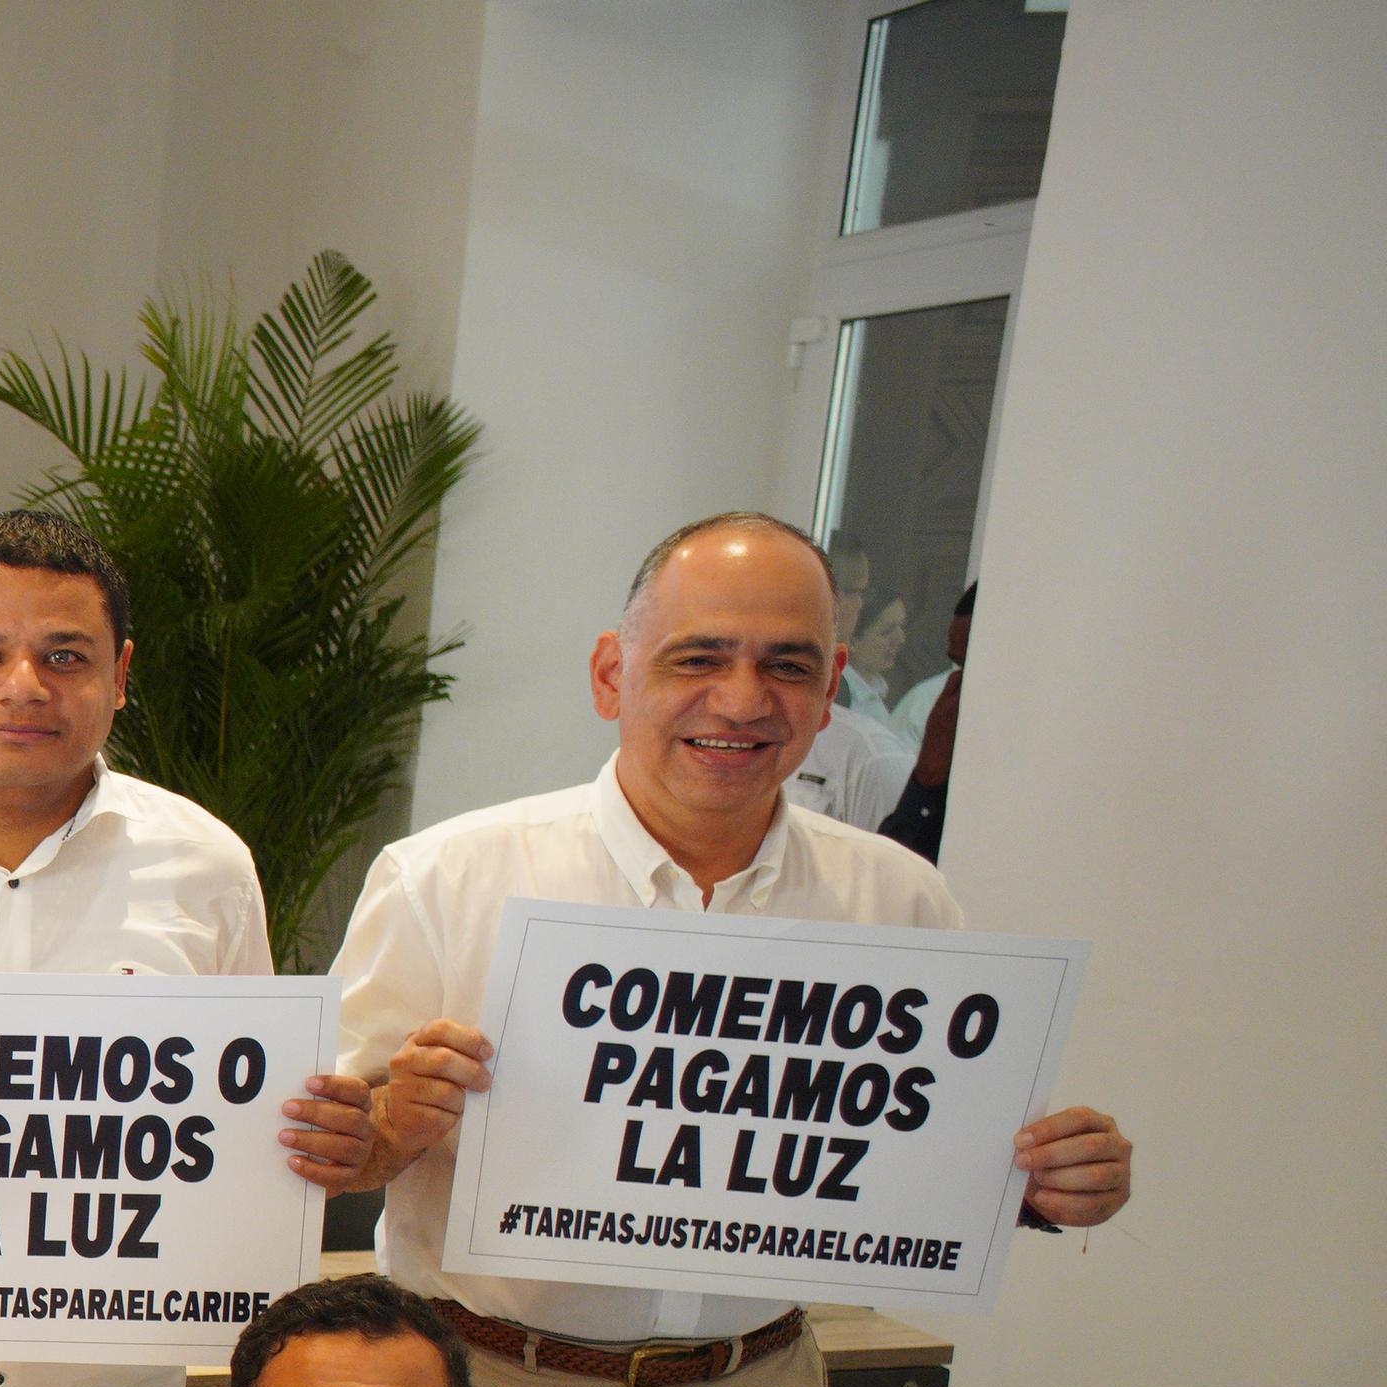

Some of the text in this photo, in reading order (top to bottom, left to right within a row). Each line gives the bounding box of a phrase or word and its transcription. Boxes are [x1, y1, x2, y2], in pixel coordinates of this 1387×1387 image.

[563, 964, 999, 1059] COMEMOS O
[218, 1038, 266, 1104] O
[584, 1042, 936, 1131] PAGAMOS
[616, 1120, 870, 1201] LA LUZ
[27, 1192, 161, 1258] LUZ
[500, 1204, 962, 1271] #TARIFASJUSTASPARAELCARIBE
